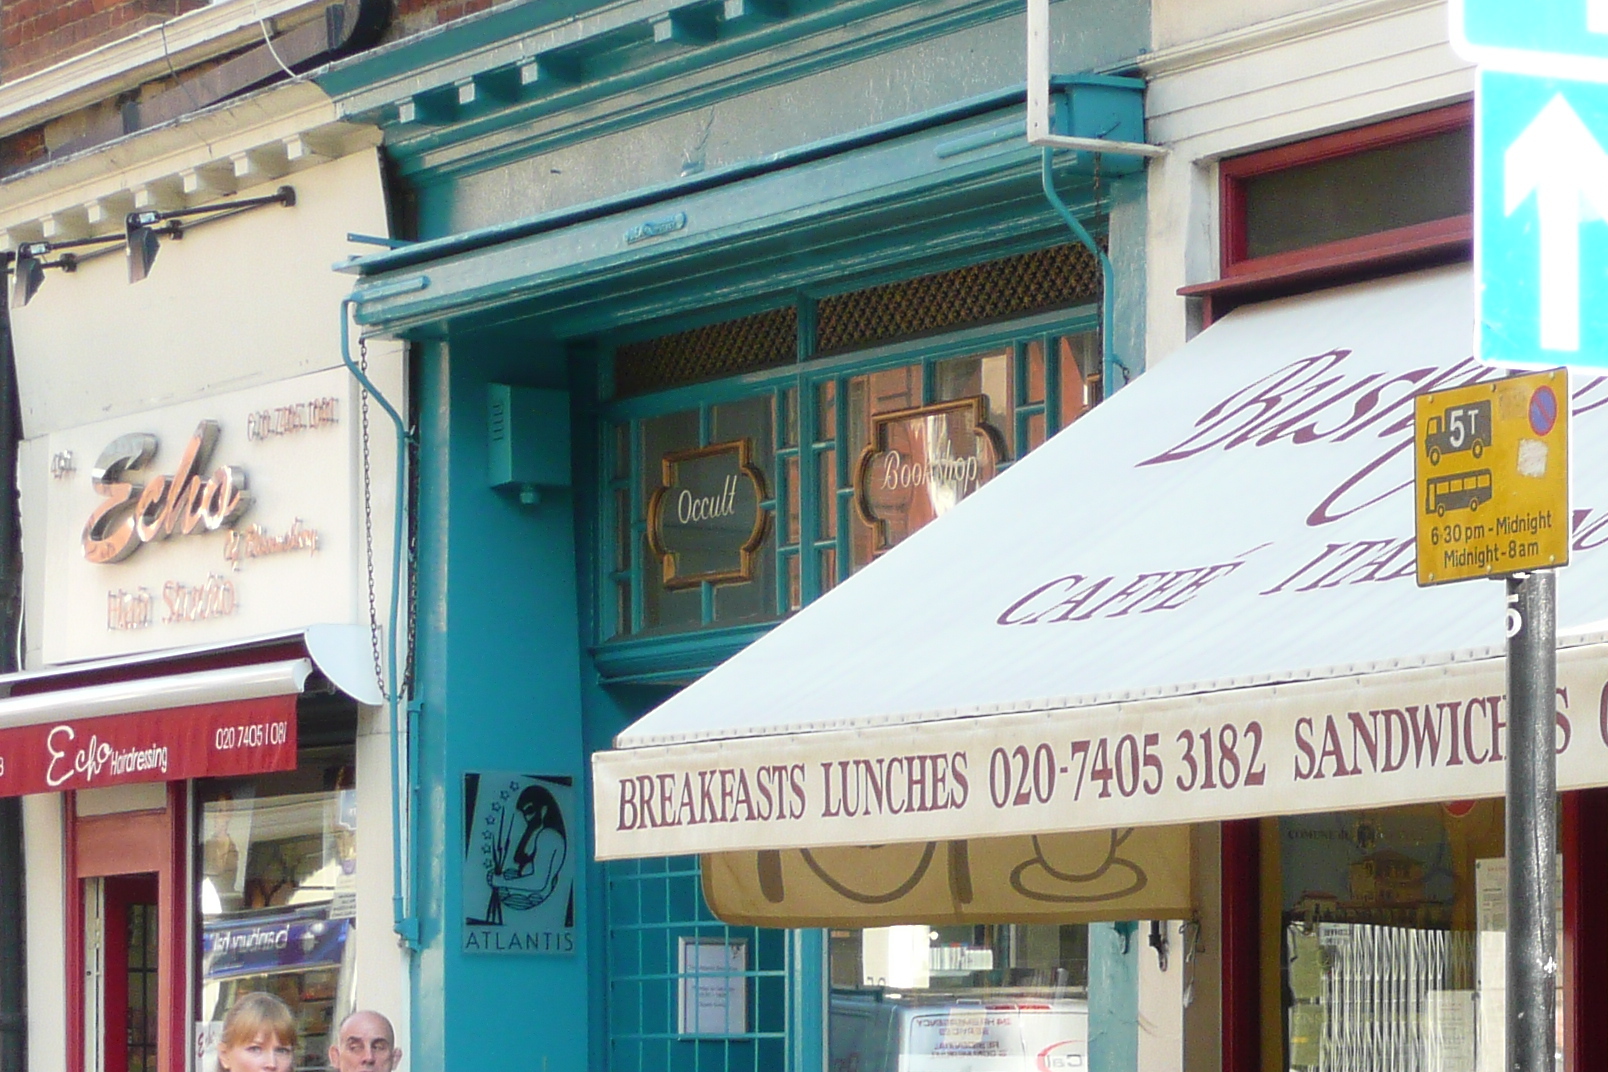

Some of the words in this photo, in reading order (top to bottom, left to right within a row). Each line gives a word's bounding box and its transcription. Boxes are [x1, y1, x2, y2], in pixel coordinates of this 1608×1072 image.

[81, 418, 257, 565] Echo
[880, 438, 979, 496] Bookshop
[677, 474, 739, 525] Occult
[1465, 525, 1485, 544] pm
[1496, 511, 1553, 537] Midnight
[46, 725, 112, 787] Echo
[109, 744, 168, 776] Hairdressing
[215, 727, 236, 750] 020
[237, 725, 262, 749] 7405
[615, 763, 807, 832] BREAKFASTS
[820, 750, 970, 818] LUNCHES
[988, 733, 1164, 809] 020-7405
[1175, 720, 1267, 792] 3182
[1294, 686, 1572, 782] SANDWICHS
[465, 930, 574, 952] ATLANTIS
